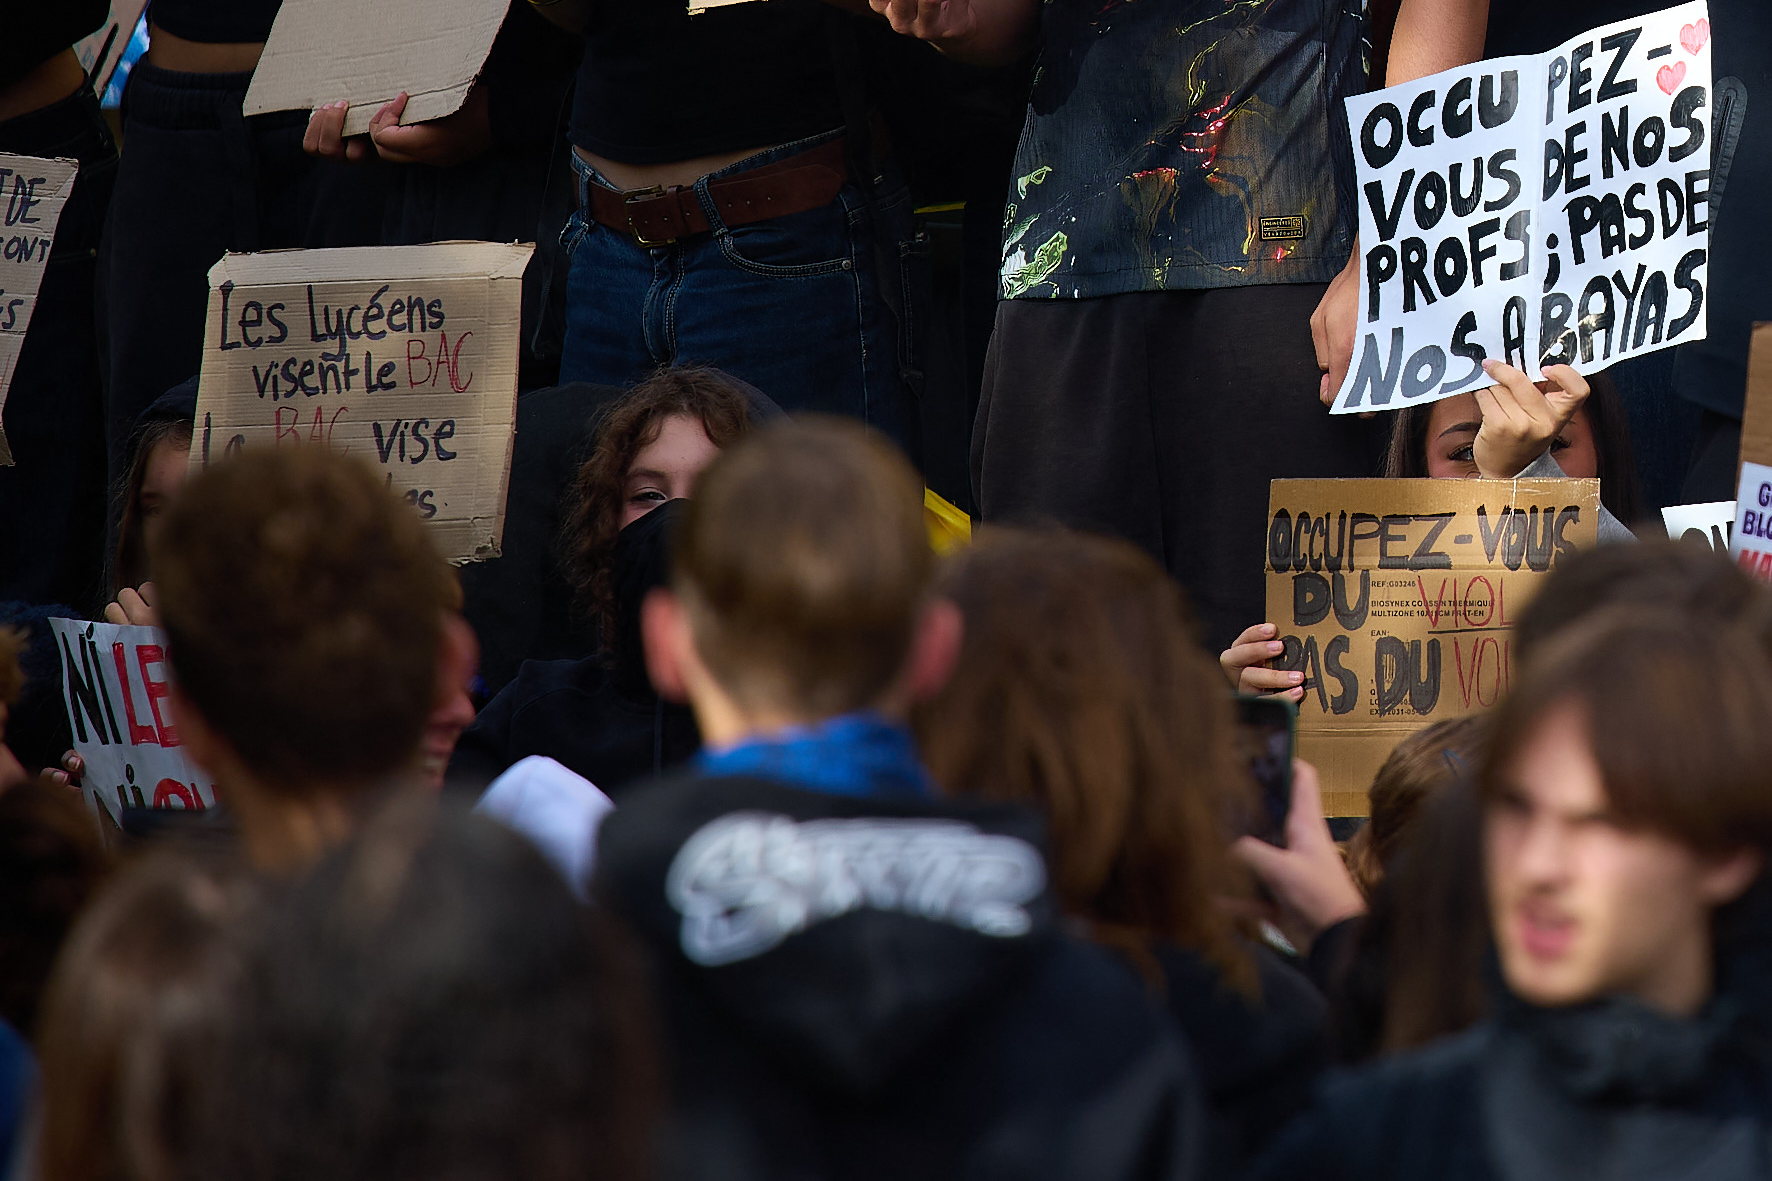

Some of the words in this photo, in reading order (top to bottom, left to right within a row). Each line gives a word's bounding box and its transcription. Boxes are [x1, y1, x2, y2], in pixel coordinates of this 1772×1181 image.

[1363, 148, 1524, 242] VOUS
[1542, 125, 1590, 203] DE
[1366, 209, 1532, 324] PROFS
[1562, 181, 1653, 266] PAS
[1656, 169, 1710, 238] DE
[219, 280, 289, 351] Les
[406, 330, 474, 394] BAC
[1292, 569, 1370, 631] DU
[112, 642, 187, 748] LE
[1271, 635, 1359, 716] PAS
[1375, 635, 1442, 718] DU
